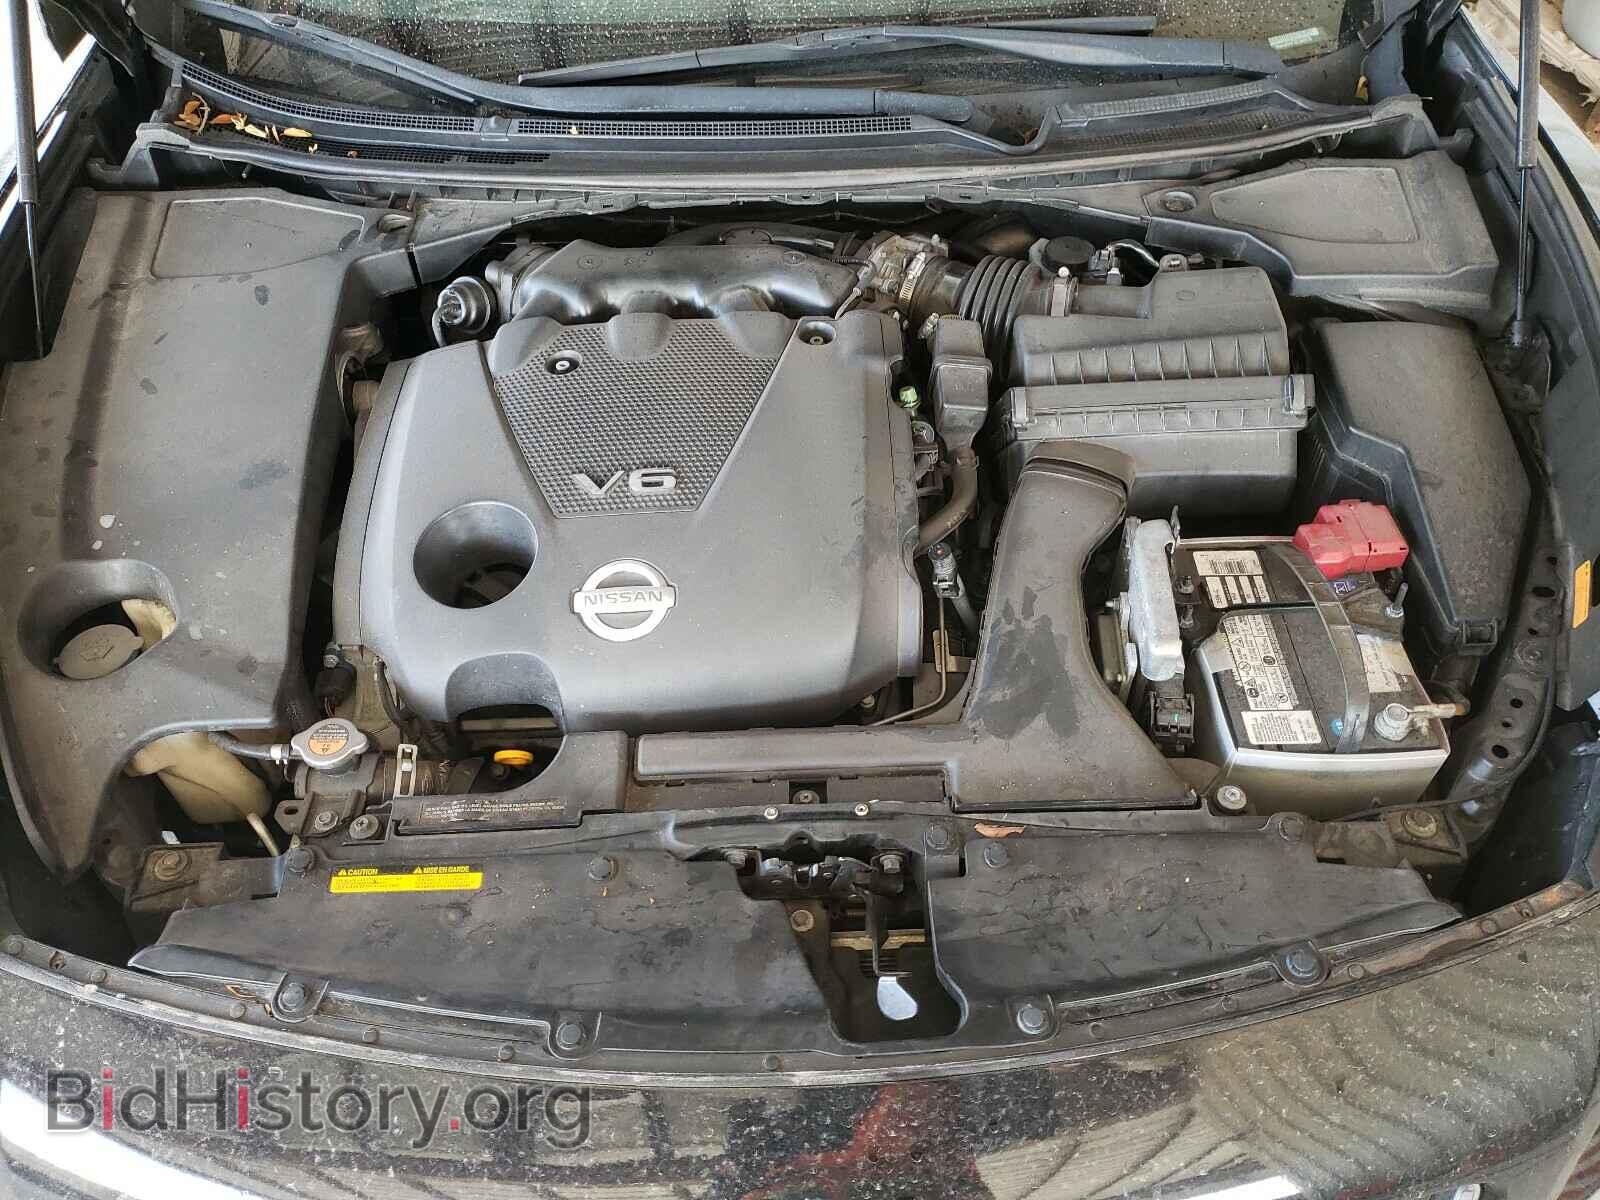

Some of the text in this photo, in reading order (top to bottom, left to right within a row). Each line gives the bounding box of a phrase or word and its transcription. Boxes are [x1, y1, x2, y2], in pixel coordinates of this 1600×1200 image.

[571, 467, 677, 496] V6
[584, 590, 664, 608] NISSAN
[348, 868, 378, 876] CAUTION
